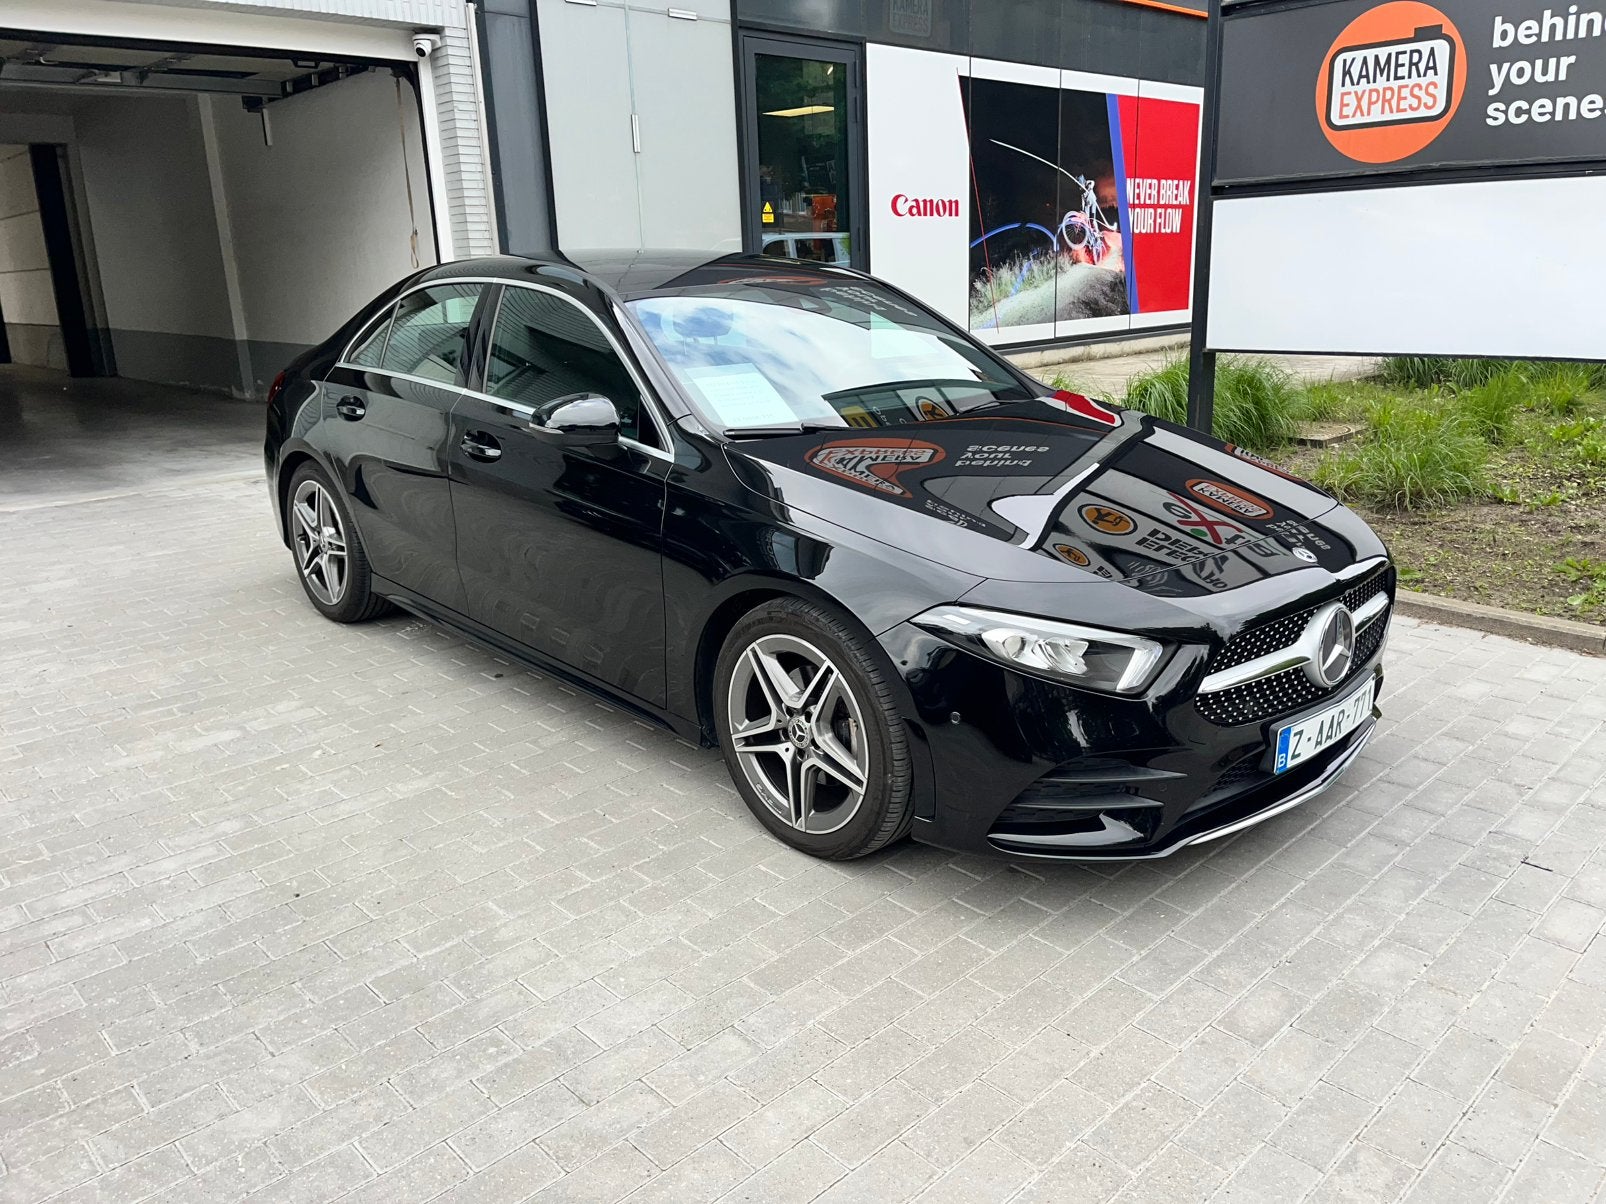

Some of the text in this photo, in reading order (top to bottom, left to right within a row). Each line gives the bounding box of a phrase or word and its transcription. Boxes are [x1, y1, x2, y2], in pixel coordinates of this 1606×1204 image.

[1492, 4, 1606, 49] behin
[1341, 46, 1438, 88] KAMERA
[1488, 55, 1577, 96] your
[1338, 81, 1438, 119] EXPRESS
[1485, 93, 1606, 126] scene
[891, 193, 959, 217] Canon
[1126, 178, 1191, 205] NEVER BREAK
[1128, 207, 1182, 234] YOUR FLOW
[1290, 684, 1373, 761] Z-AAR-771
[1277, 753, 1286, 767] B
